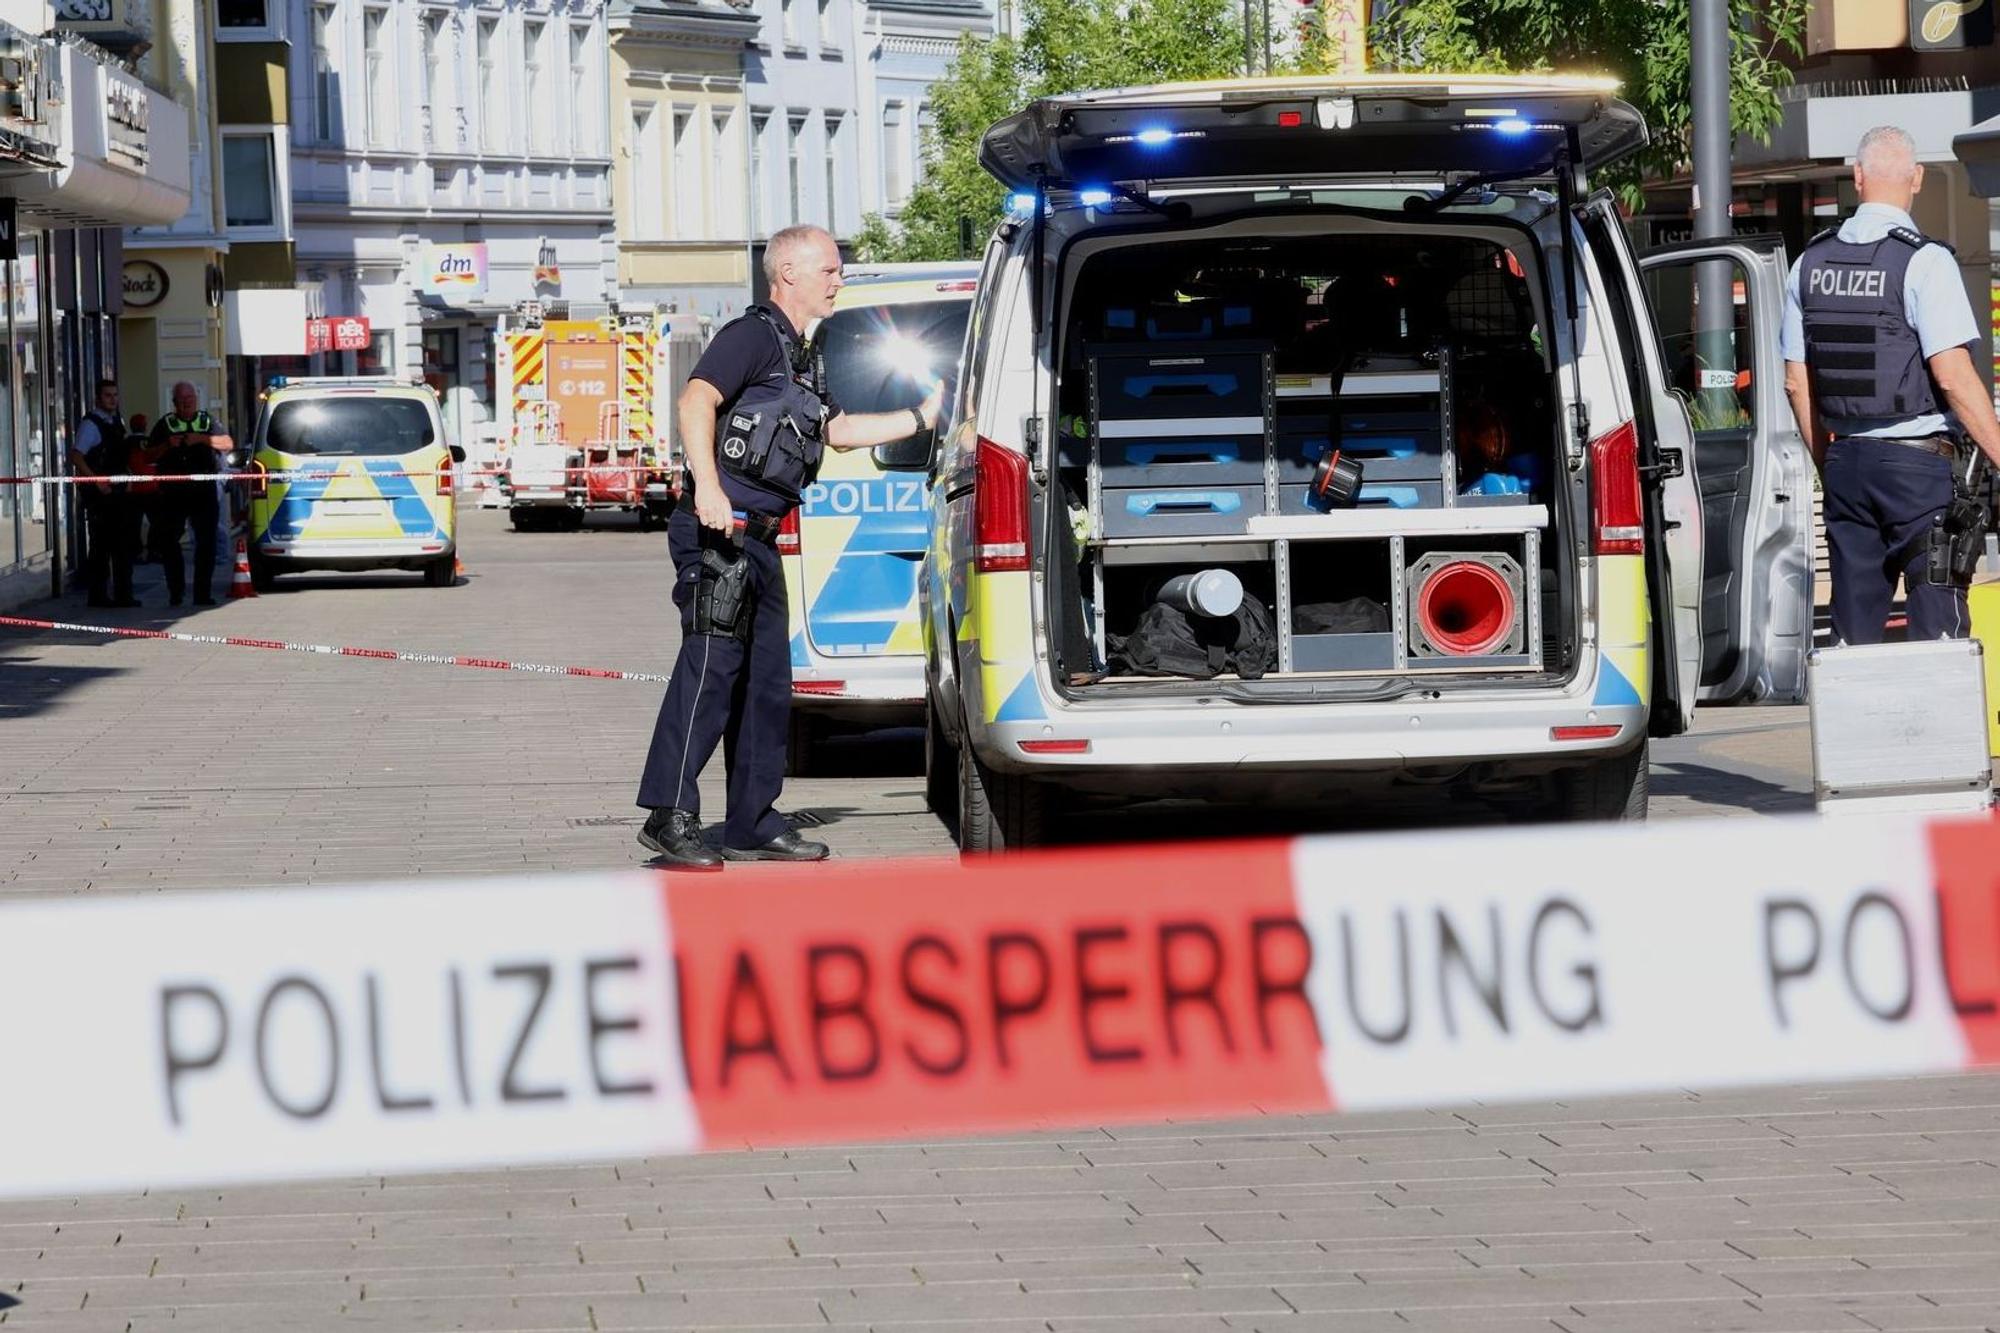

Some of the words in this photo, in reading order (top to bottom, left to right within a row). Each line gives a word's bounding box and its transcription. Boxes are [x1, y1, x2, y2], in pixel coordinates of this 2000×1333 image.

[440, 253, 471, 273] dm
[1809, 268, 1887, 297] POLIZEI
[337, 322, 365, 337] DER
[339, 337, 365, 348] TOUR
[577, 381, 606, 396] 112
